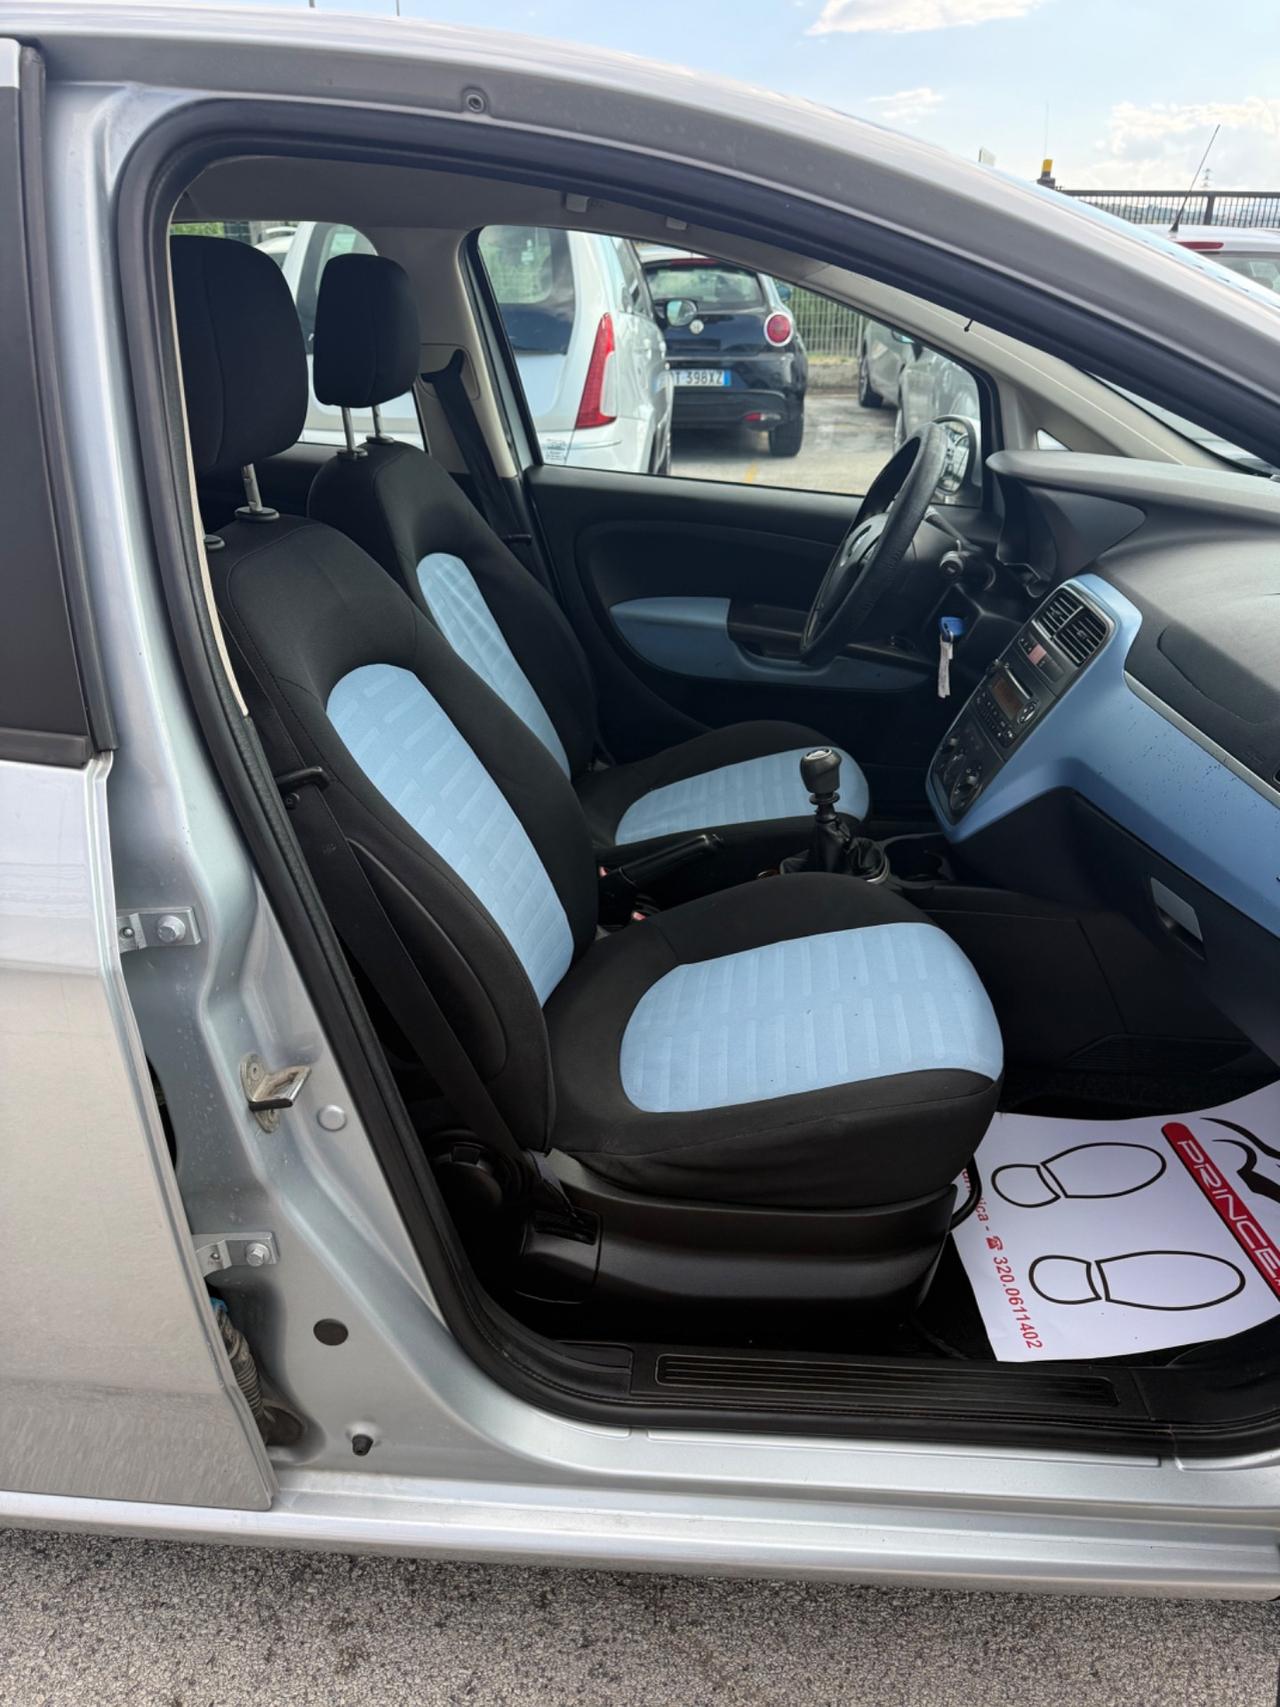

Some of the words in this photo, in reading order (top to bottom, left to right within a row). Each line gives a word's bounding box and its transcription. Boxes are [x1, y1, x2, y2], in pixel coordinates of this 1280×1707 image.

[687, 370, 723, 385] 398XZ
[1177, 1139, 1280, 1286] PRINCE
[993, 1256, 1043, 1349] 320.0611402
